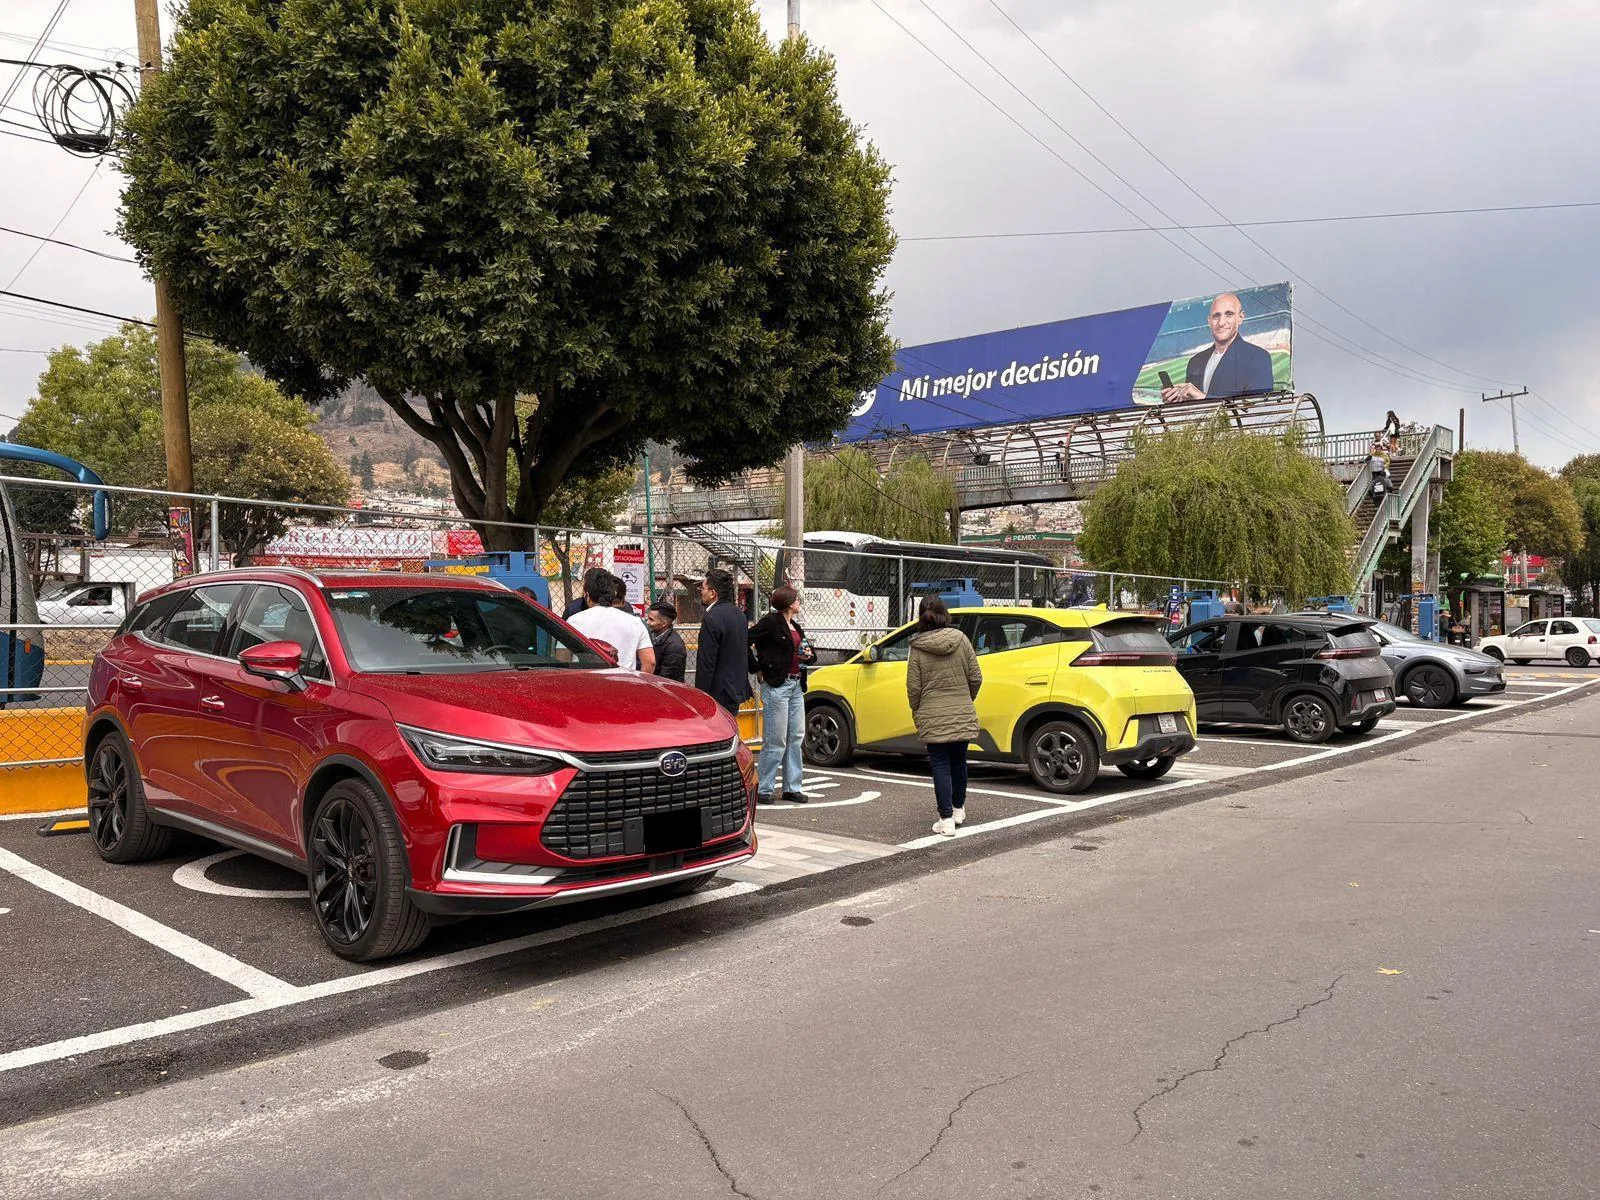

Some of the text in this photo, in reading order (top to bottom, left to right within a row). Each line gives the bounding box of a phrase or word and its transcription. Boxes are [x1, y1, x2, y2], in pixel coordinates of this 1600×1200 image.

[899, 350, 1100, 401] Mi mejor decisión
[664, 758, 685, 770] BYD
